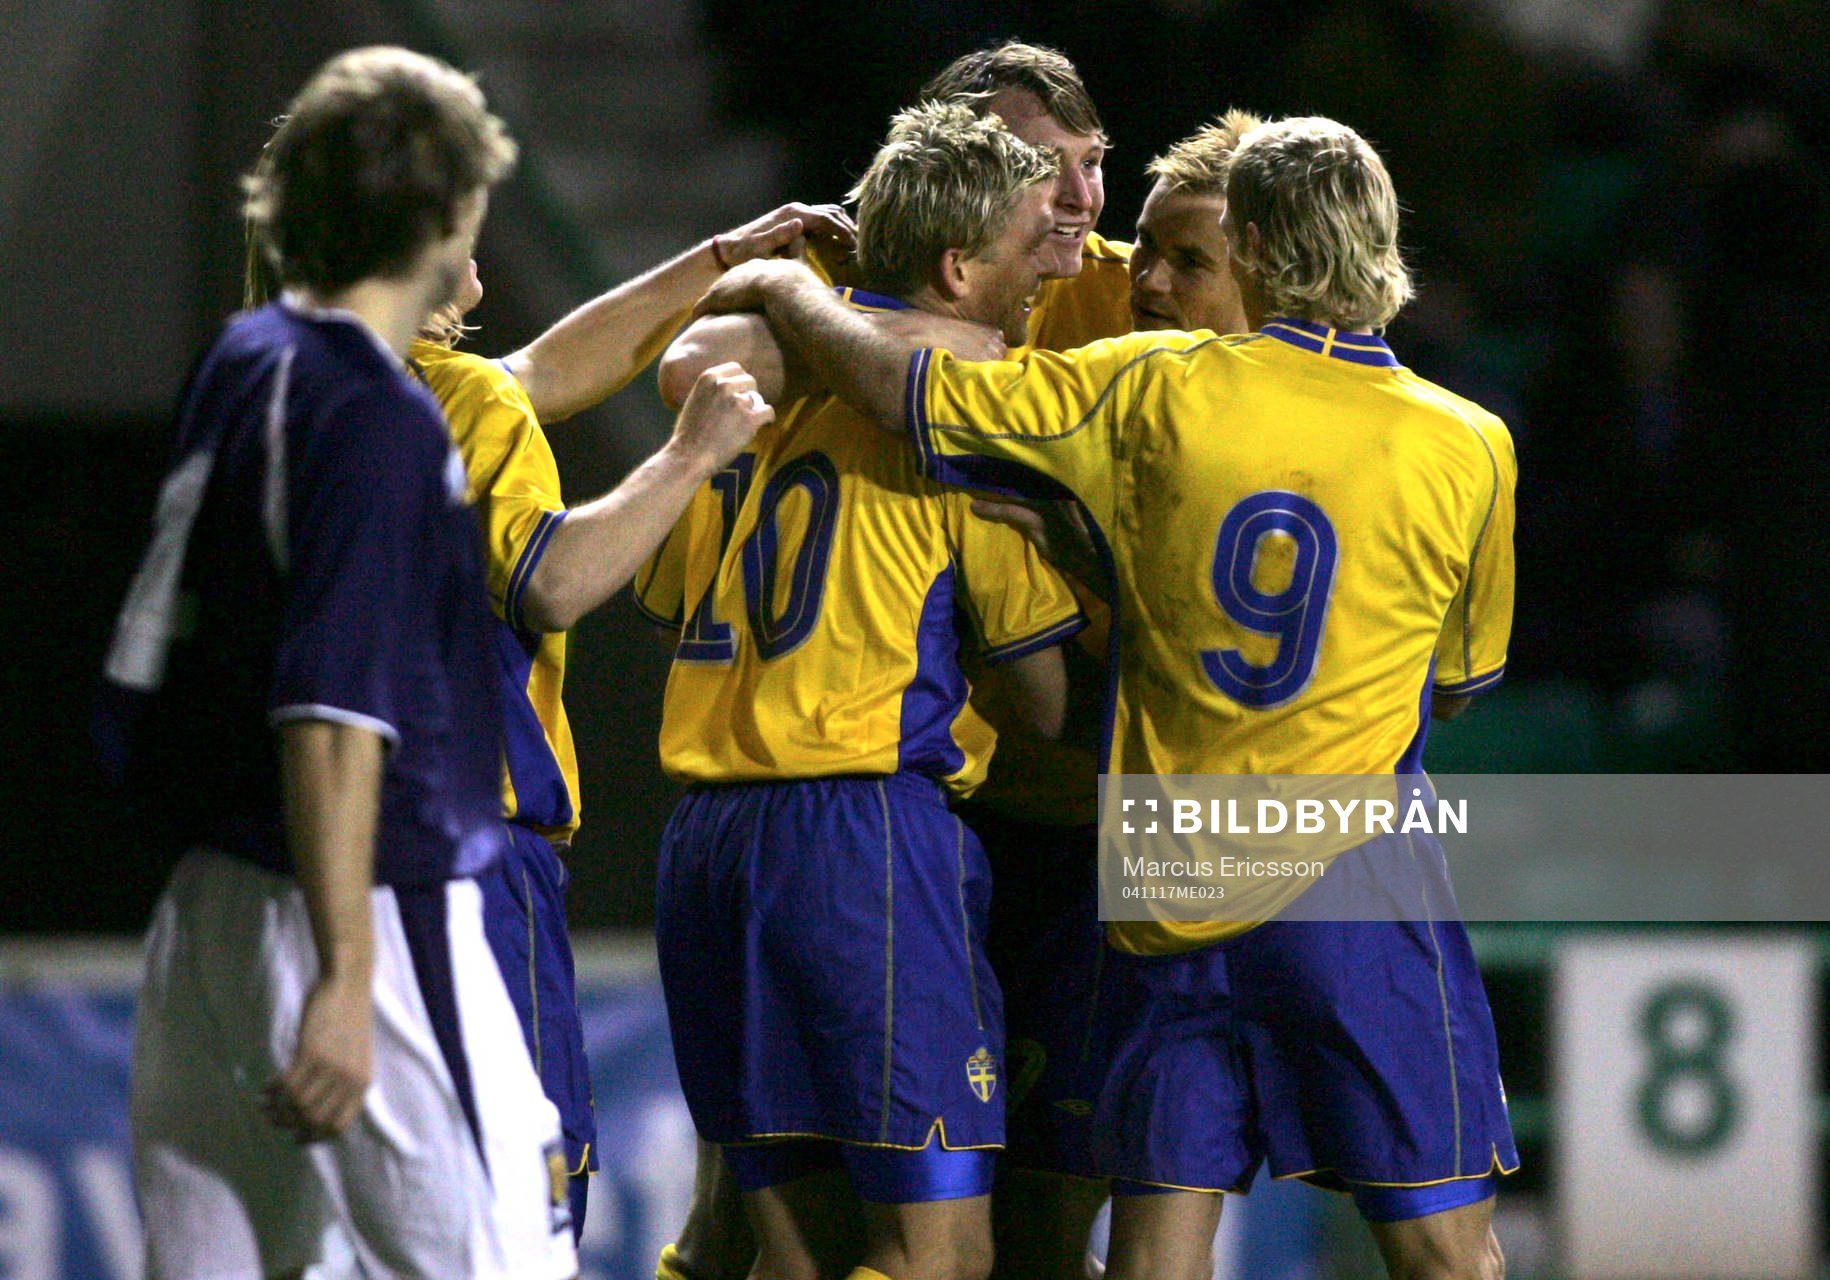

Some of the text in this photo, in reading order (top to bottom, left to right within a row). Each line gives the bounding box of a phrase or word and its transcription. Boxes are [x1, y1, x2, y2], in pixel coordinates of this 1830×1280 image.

[675, 449, 840, 662] 10
[1199, 488, 1339, 709] 9
[1633, 976, 1741, 1163] 8
